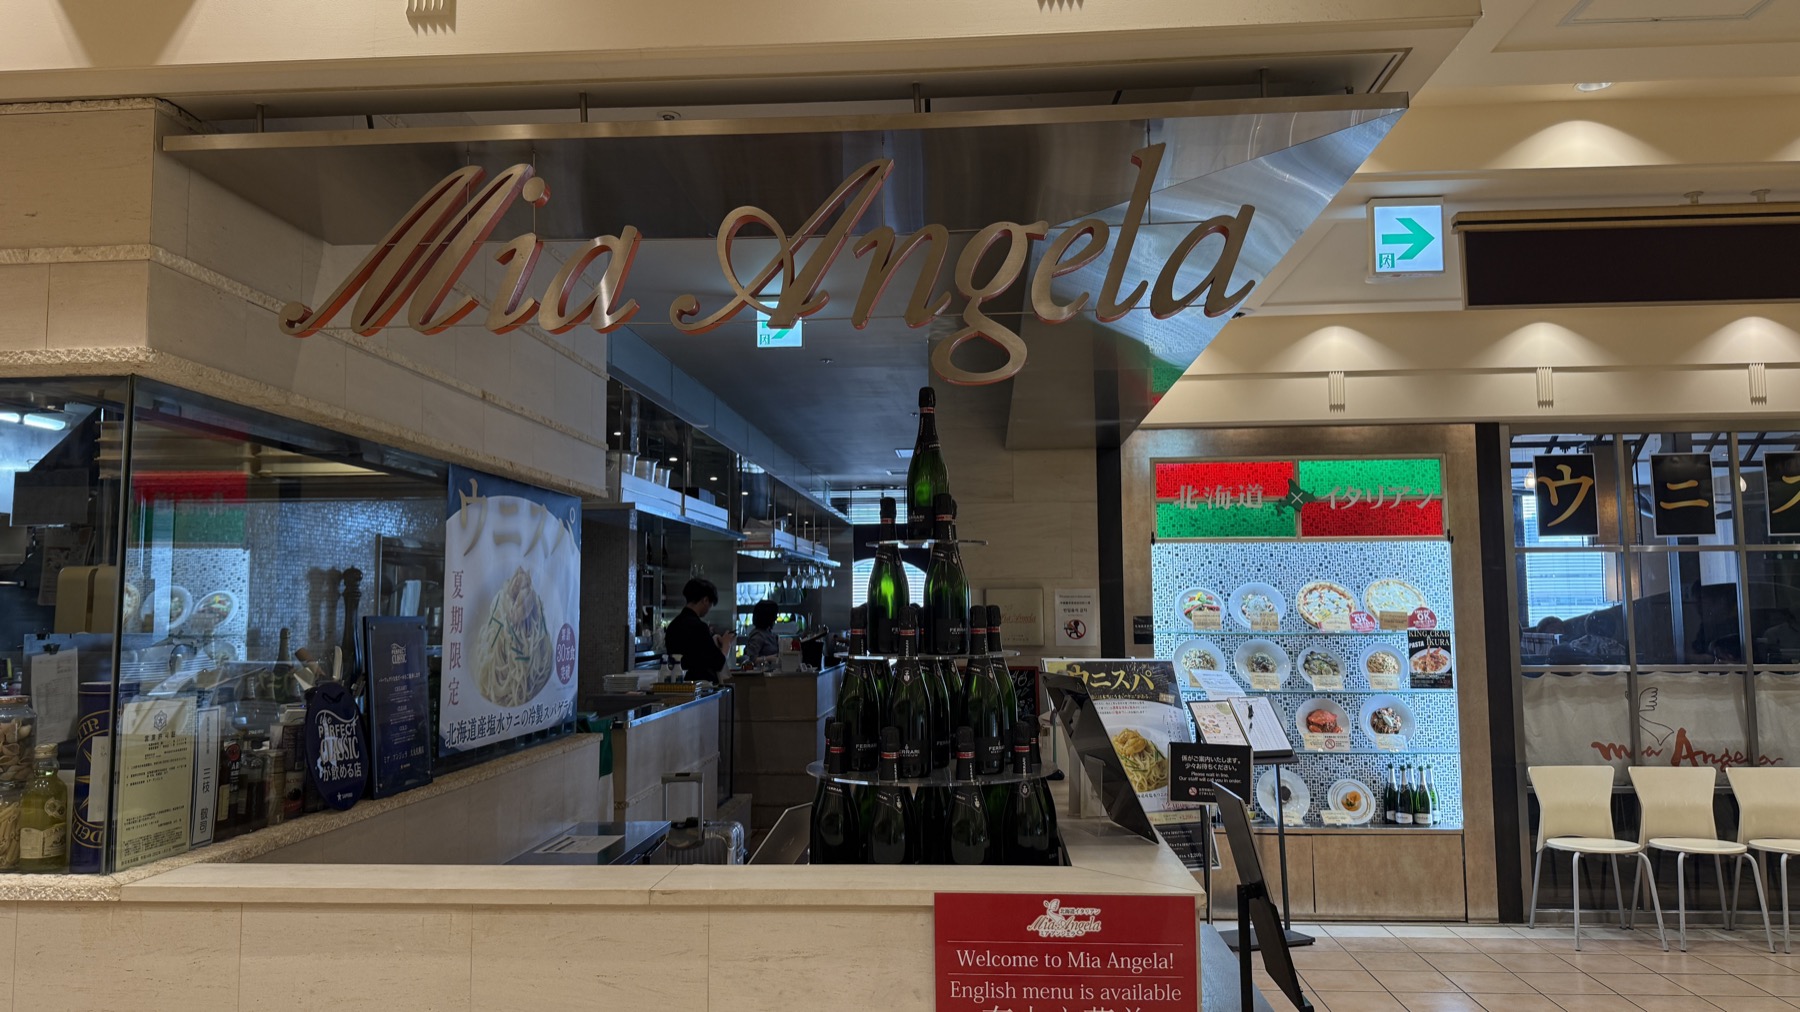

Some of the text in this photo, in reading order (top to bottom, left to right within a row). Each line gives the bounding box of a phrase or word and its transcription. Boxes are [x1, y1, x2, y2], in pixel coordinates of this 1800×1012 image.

[278, 142, 1255, 386] Mia Angela
[1173, 483, 1264, 510] 北海道
[1322, 484, 1435, 510] イタリアン
[1537, 464, 1594, 527] ウ
[459, 477, 576, 557] ウニスパ
[1417, 612, 1431, 620] OK
[448, 570, 465, 706] 夏期限定
[1408, 641, 1425, 649] PASTA
[323, 761, 362, 782] が飲める店
[1027, 914, 1101, 936] Mia Angela
[956, 950, 1174, 974] Welcome to Mia Angela!
[950, 981, 1182, 1003] English menu is available
